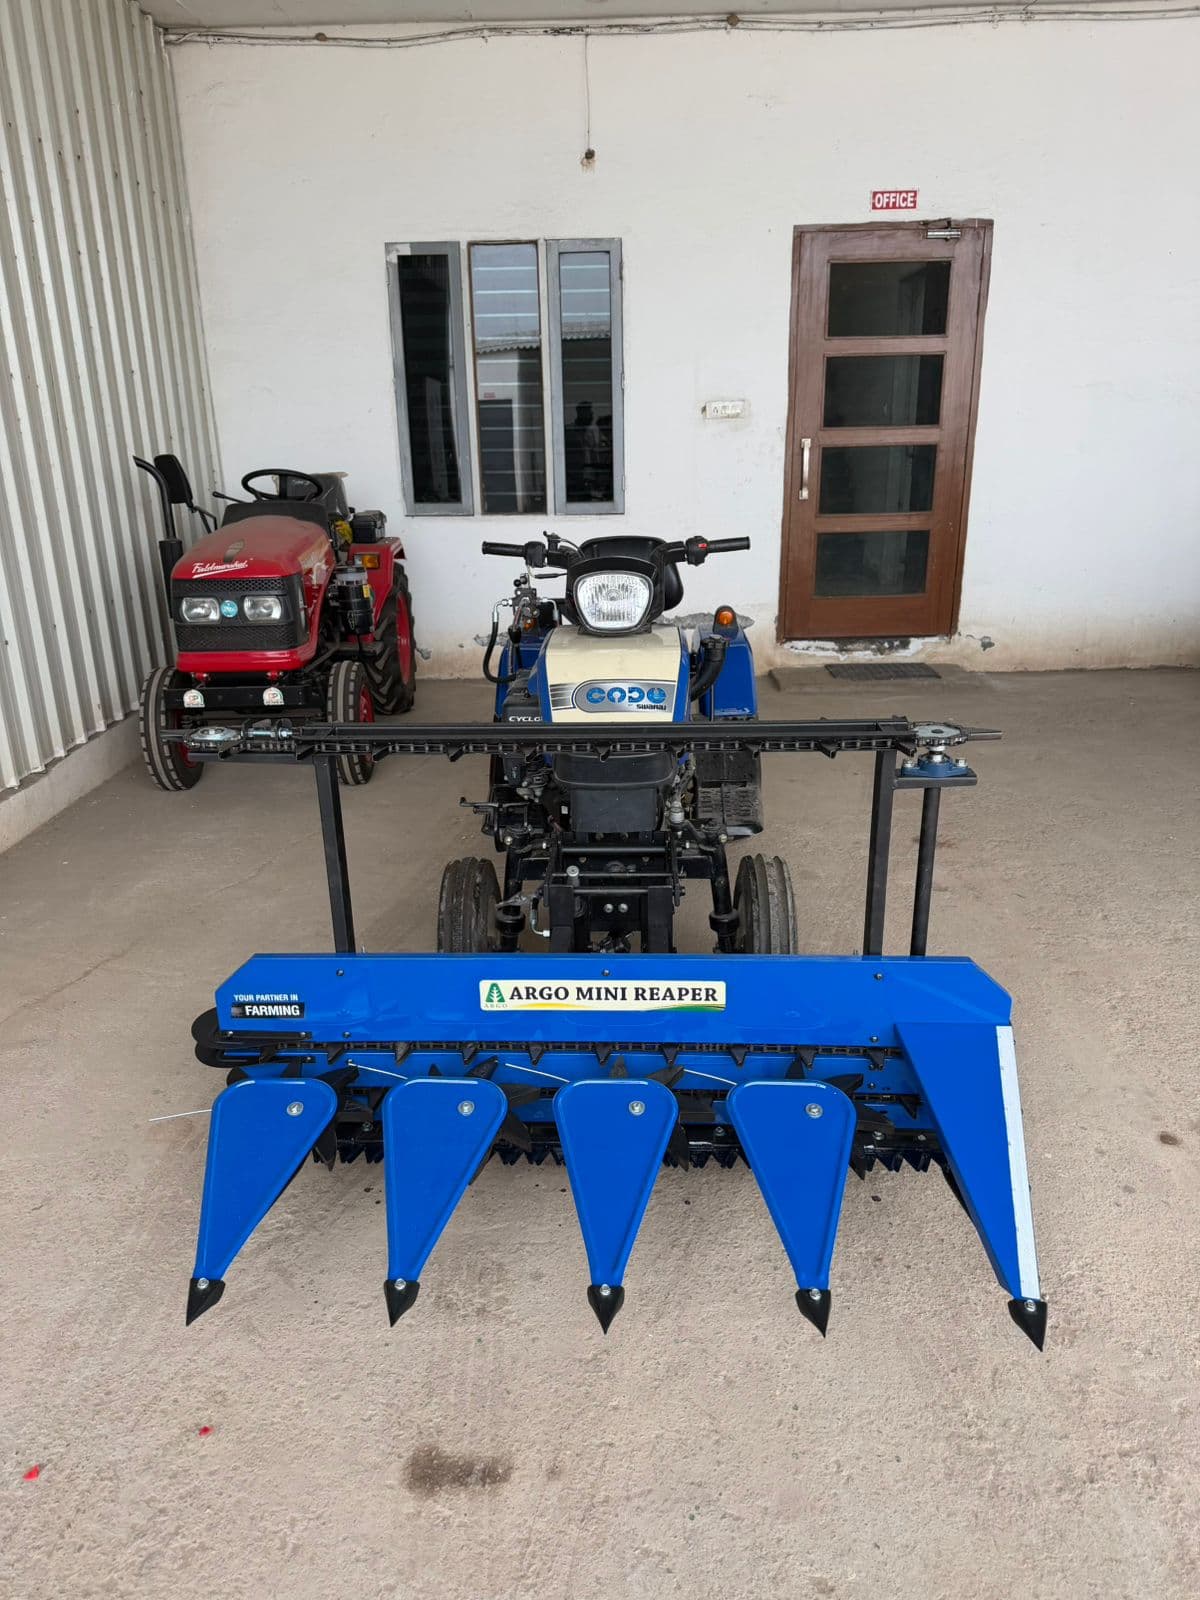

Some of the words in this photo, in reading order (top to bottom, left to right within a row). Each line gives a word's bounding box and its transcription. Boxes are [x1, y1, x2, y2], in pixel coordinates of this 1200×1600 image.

[874, 192, 915, 208] OFFICE
[290, 993, 299, 1001] IN
[509, 986, 570, 1001] ARGO
[575, 986, 627, 1001] MINI
[634, 987, 718, 1002] REAPER
[244, 1005, 300, 1016] FARMING
